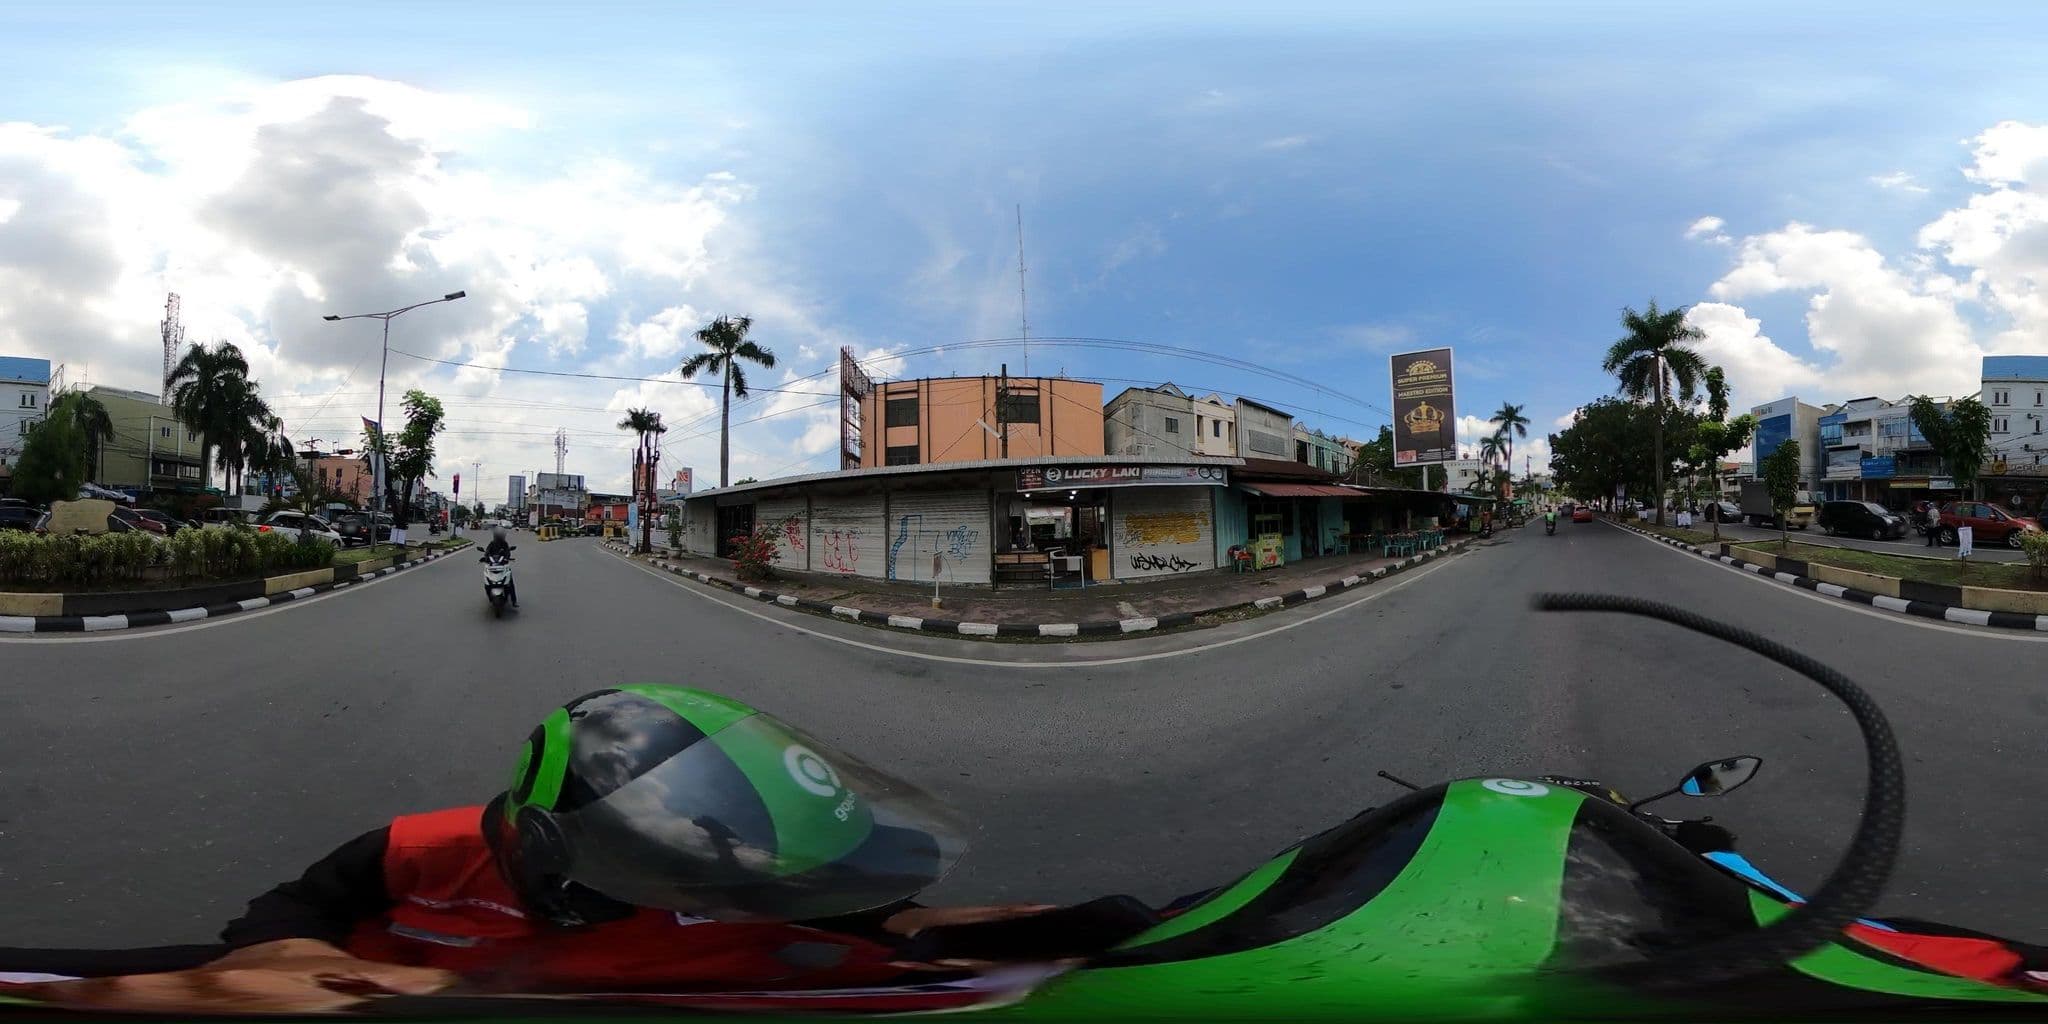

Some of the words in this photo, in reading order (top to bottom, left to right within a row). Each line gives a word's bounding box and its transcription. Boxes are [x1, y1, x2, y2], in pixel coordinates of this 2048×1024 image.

[1397, 376, 1418, 384] SUPER
[1418, 373, 1447, 382] PREMIUM
[1398, 389, 1424, 398] MAESTRO
[1425, 387, 1448, 395] EDITION
[1064, 468, 1108, 479] LUCKY
[1111, 467, 1140, 478] LAKI
